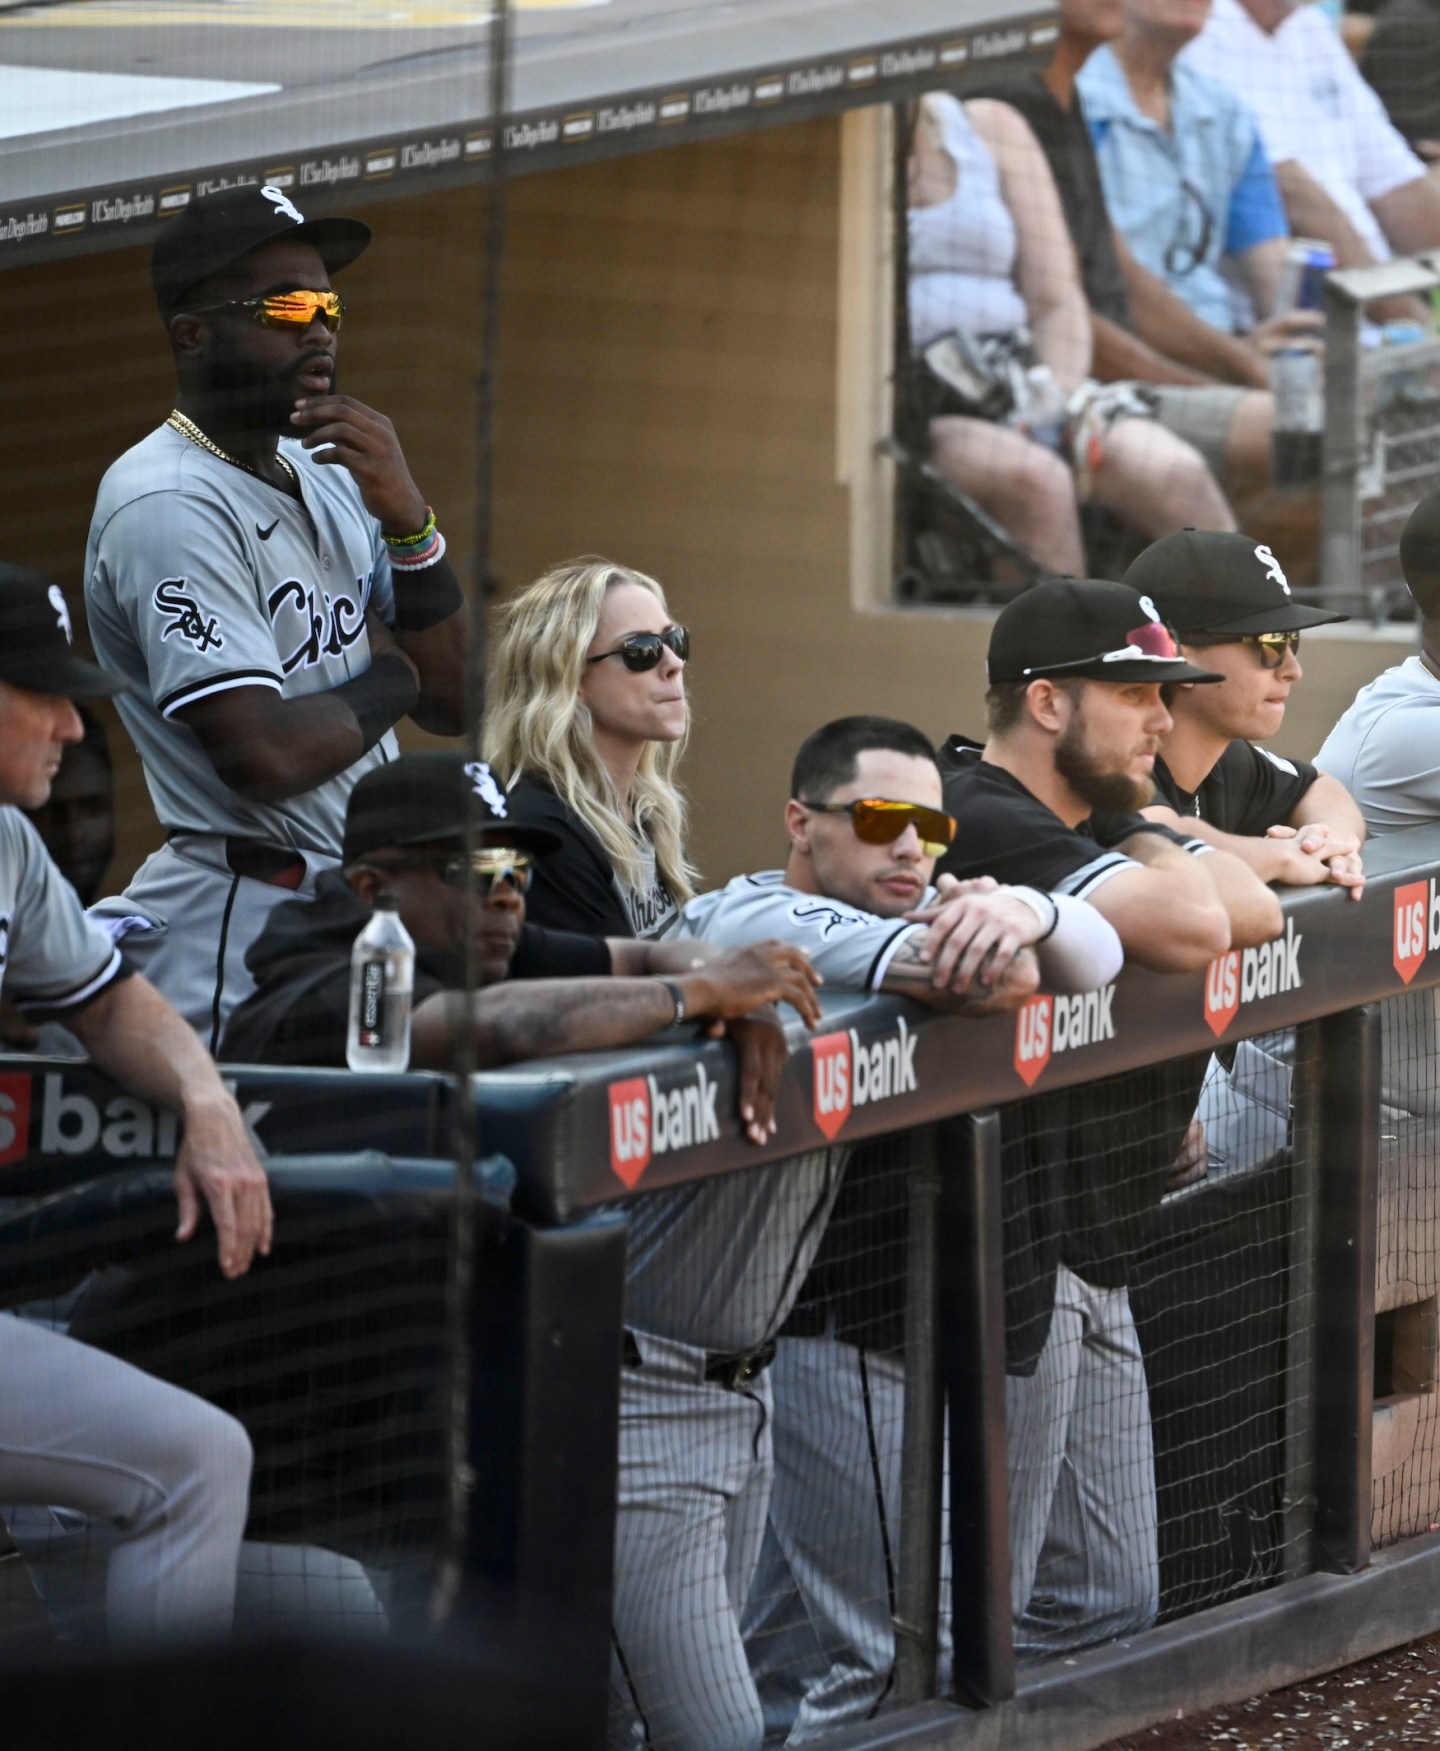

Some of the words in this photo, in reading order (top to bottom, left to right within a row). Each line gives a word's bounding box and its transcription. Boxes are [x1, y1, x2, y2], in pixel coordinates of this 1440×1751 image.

[1208, 951, 1239, 1013] us
[1241, 917, 1303, 1003] bank
[1397, 900, 1425, 960] us
[816, 1052, 849, 1115] us
[849, 1016, 918, 1106] bank
[1018, 998, 1049, 1063] us
[1052, 984, 1116, 1053] bank
[612, 1097, 649, 1162] us
[648, 1061, 719, 1154] bank
